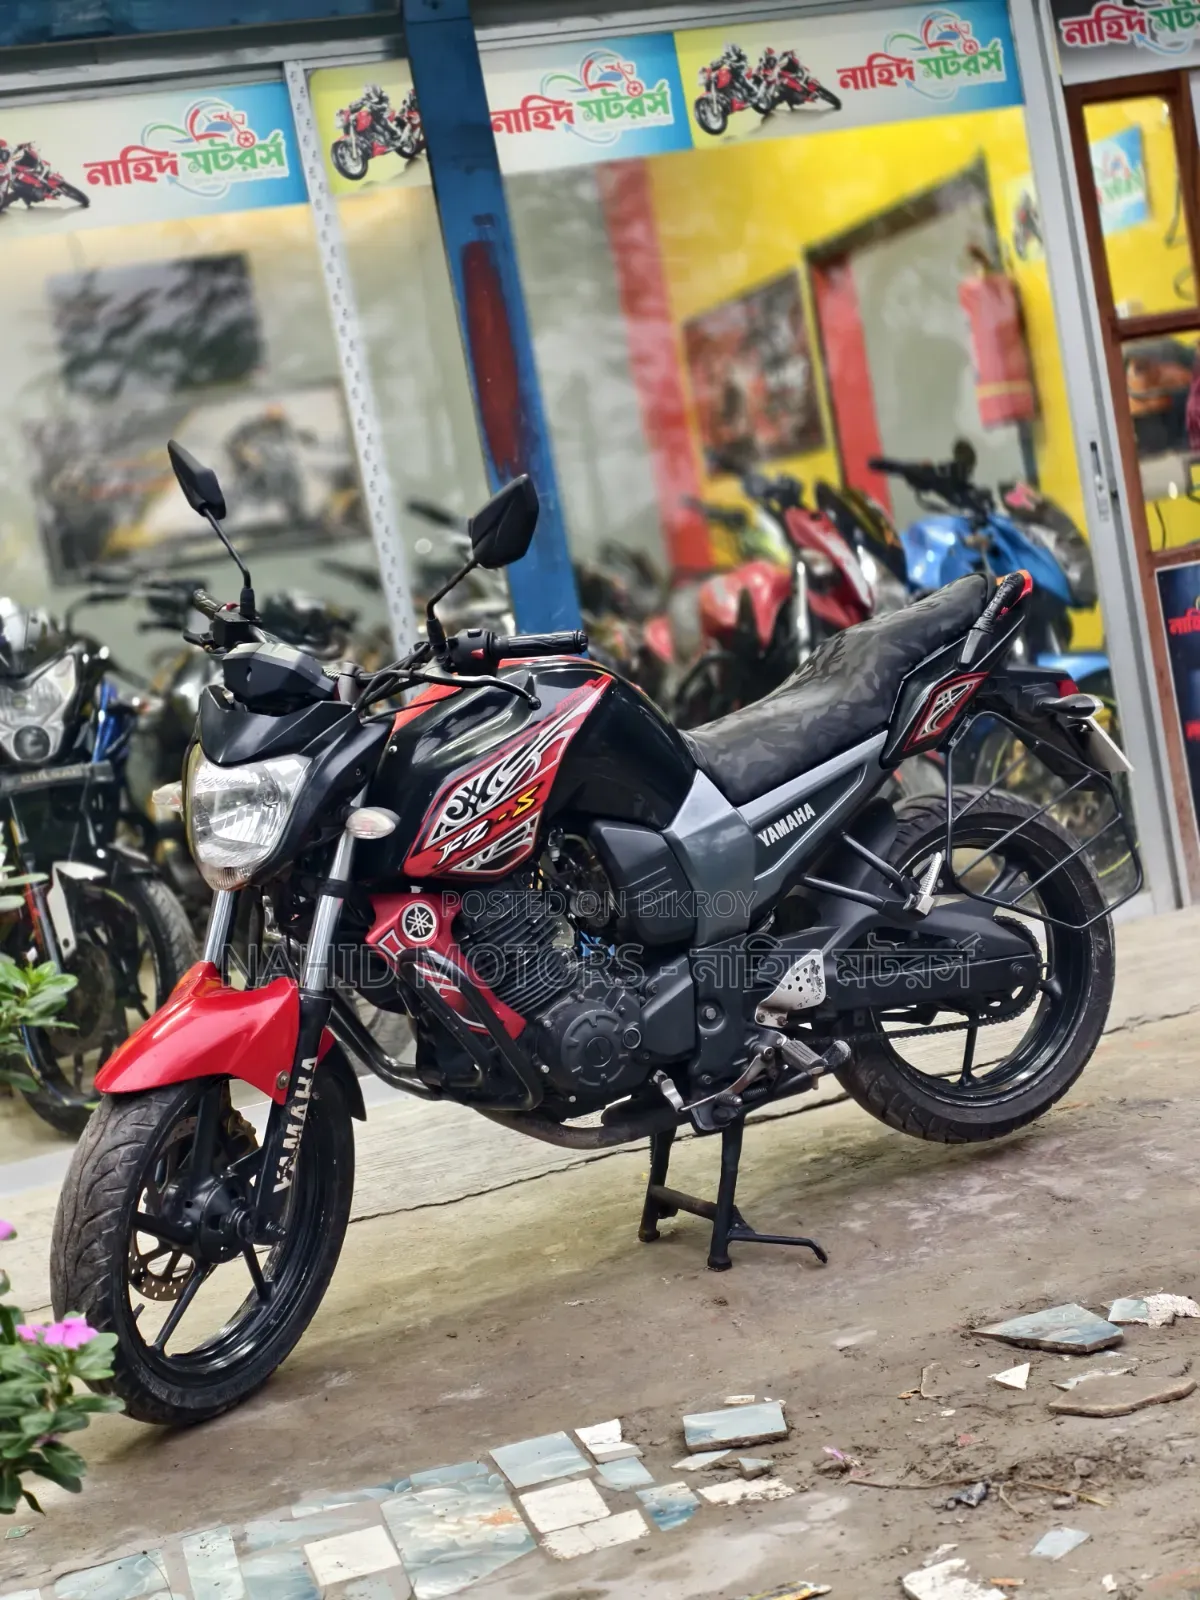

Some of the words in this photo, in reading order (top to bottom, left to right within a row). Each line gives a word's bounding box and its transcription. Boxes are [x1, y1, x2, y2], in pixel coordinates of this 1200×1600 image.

[1061, 4, 1147, 45] নাহিদ
[836, 52, 915, 90] নাহিদ
[490, 94, 575, 134] নাহিদ
[83, 145, 179, 186] নাহিদ
[757, 802, 816, 847] YAMAHA
